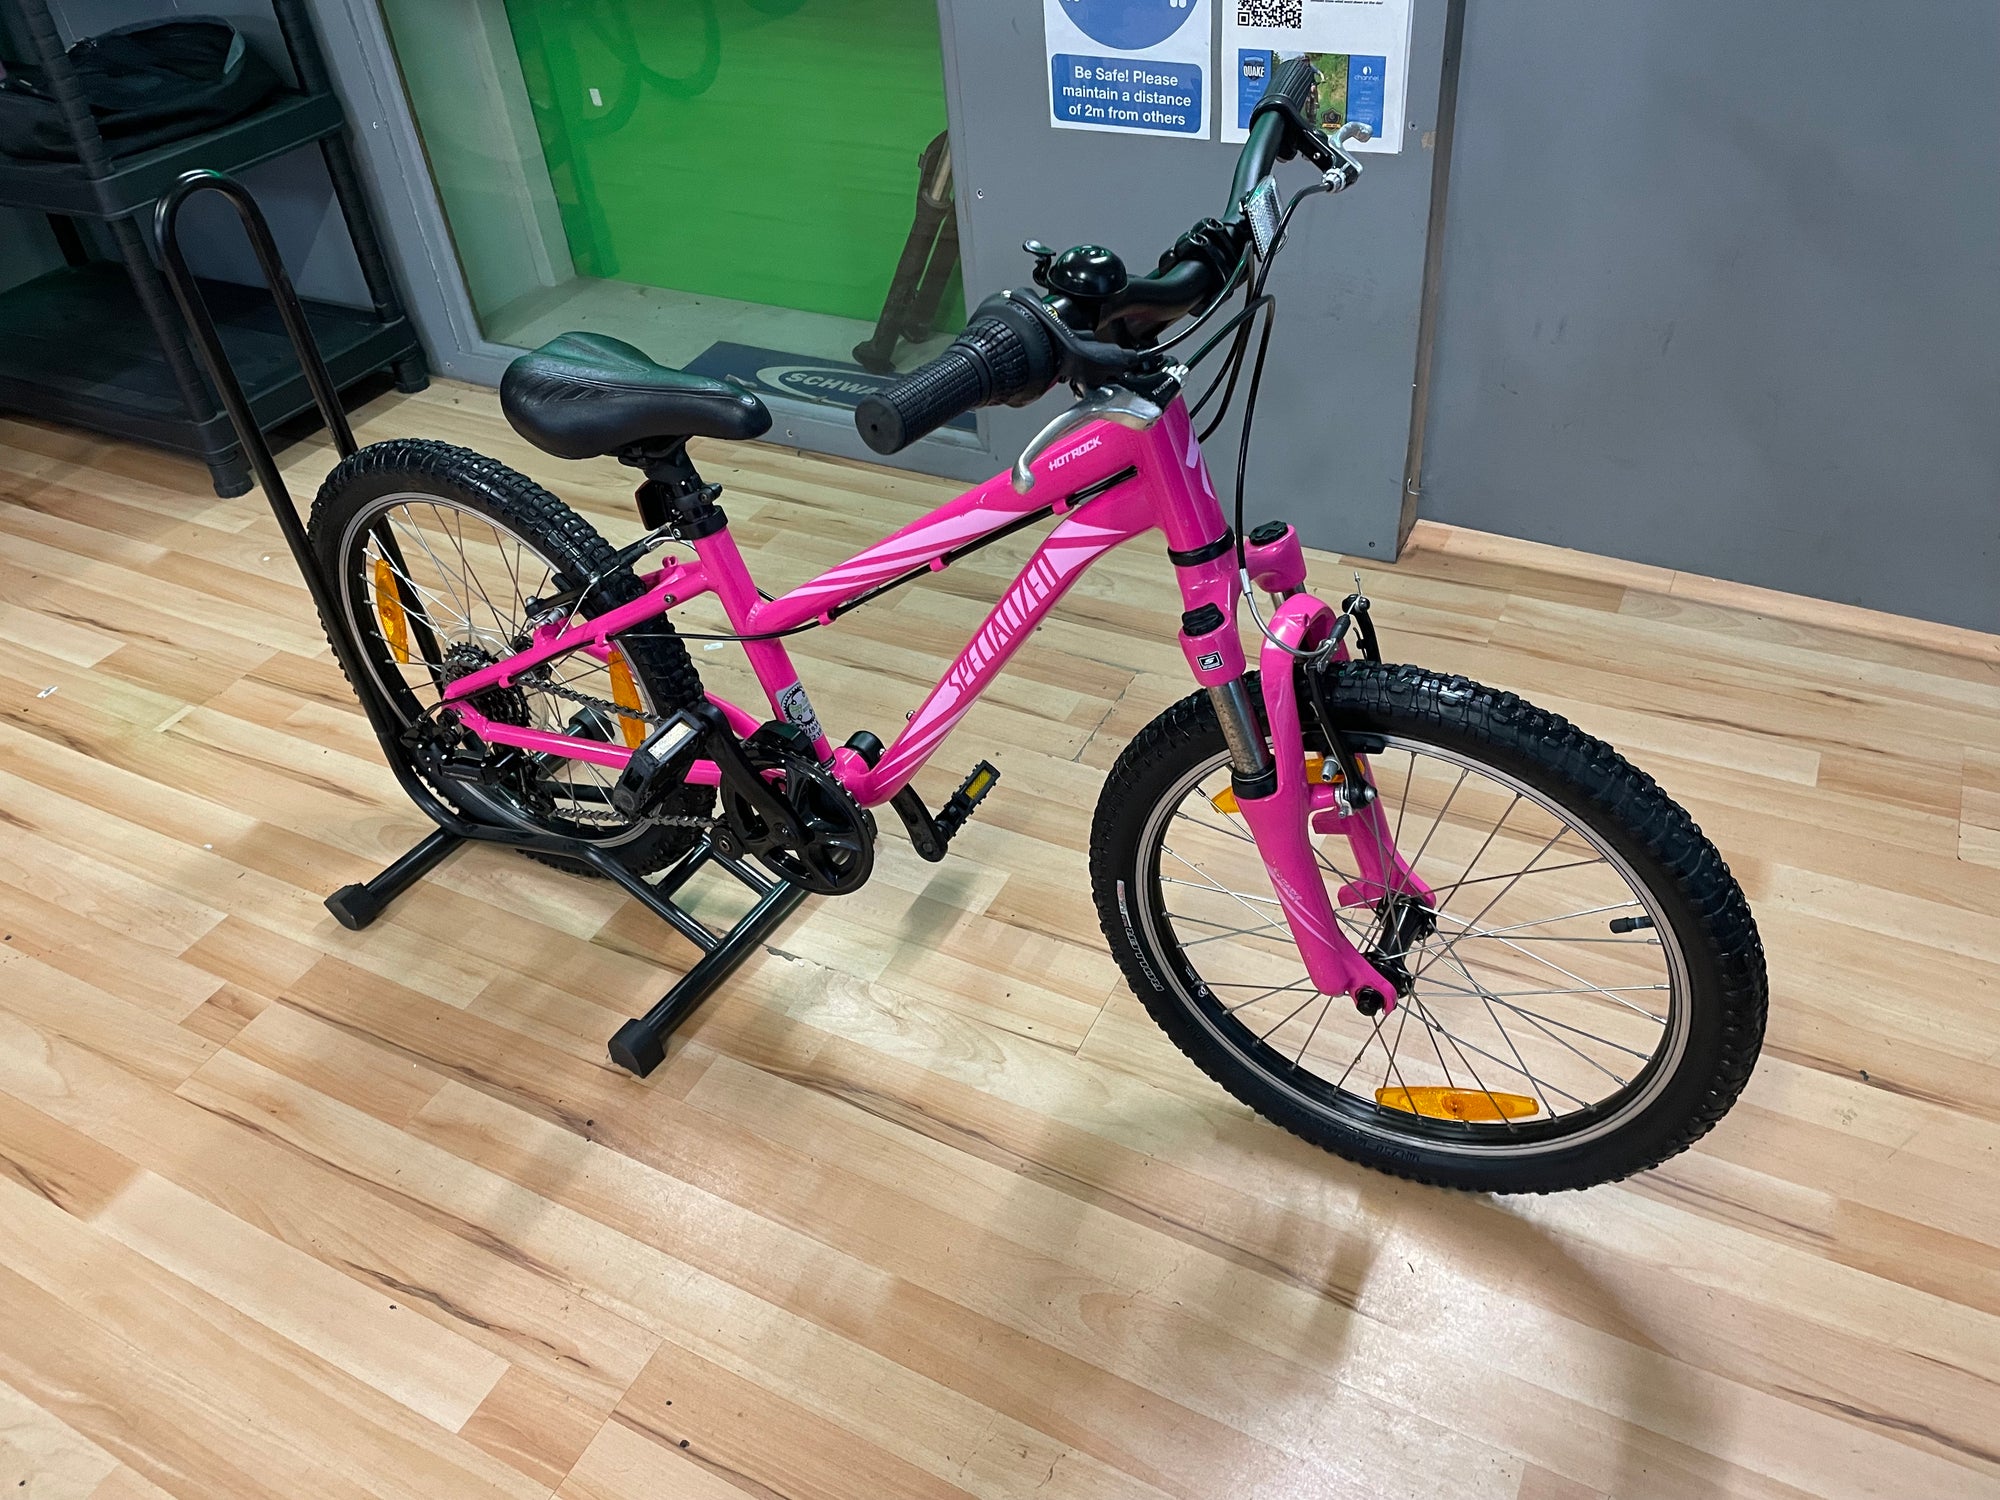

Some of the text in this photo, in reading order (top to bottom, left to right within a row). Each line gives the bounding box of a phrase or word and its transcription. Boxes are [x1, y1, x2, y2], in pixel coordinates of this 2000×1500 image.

[1074, 65, 1179, 87] Be Safe! Please
[1243, 65, 1265, 78] QUAKE
[1062, 85, 1192, 107] maintain a distance
[1068, 103, 1186, 126] of 2m from others
[784, 372, 879, 394] SCHWA
[1048, 435, 1102, 471] HOTROCK
[947, 552, 1062, 700] SPECIALIZED
